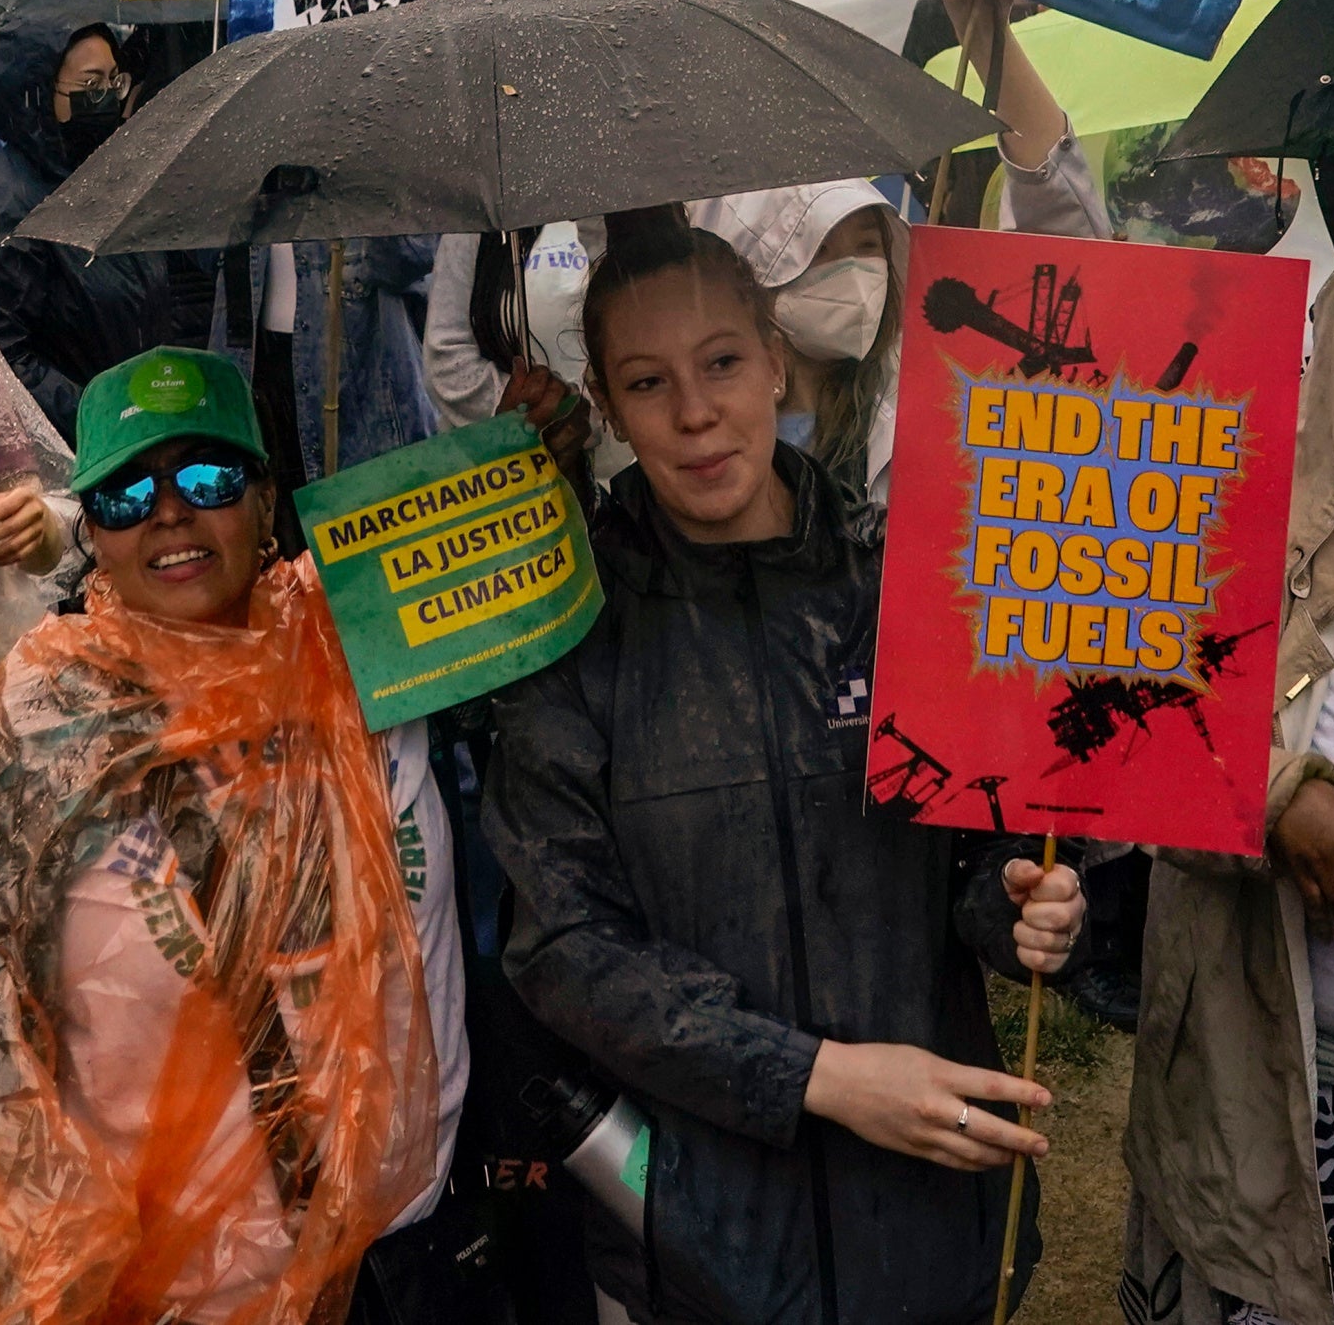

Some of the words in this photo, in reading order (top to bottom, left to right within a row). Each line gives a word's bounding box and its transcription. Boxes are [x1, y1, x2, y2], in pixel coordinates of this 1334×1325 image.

[967, 385, 1103, 457] END
[1112, 399, 1241, 470] THE
[328, 459, 525, 550] MARCHAMOS
[529, 453, 555, 475] P
[978, 456, 1117, 529] ERA
[1127, 471, 1216, 535] OF
[392, 549, 433, 580] LA
[440, 499, 559, 571] JUSTICIA
[972, 525, 1208, 606] FOSSIL
[418, 545, 567, 625] CLIMÁTICA
[985, 596, 1183, 672] FUELS
